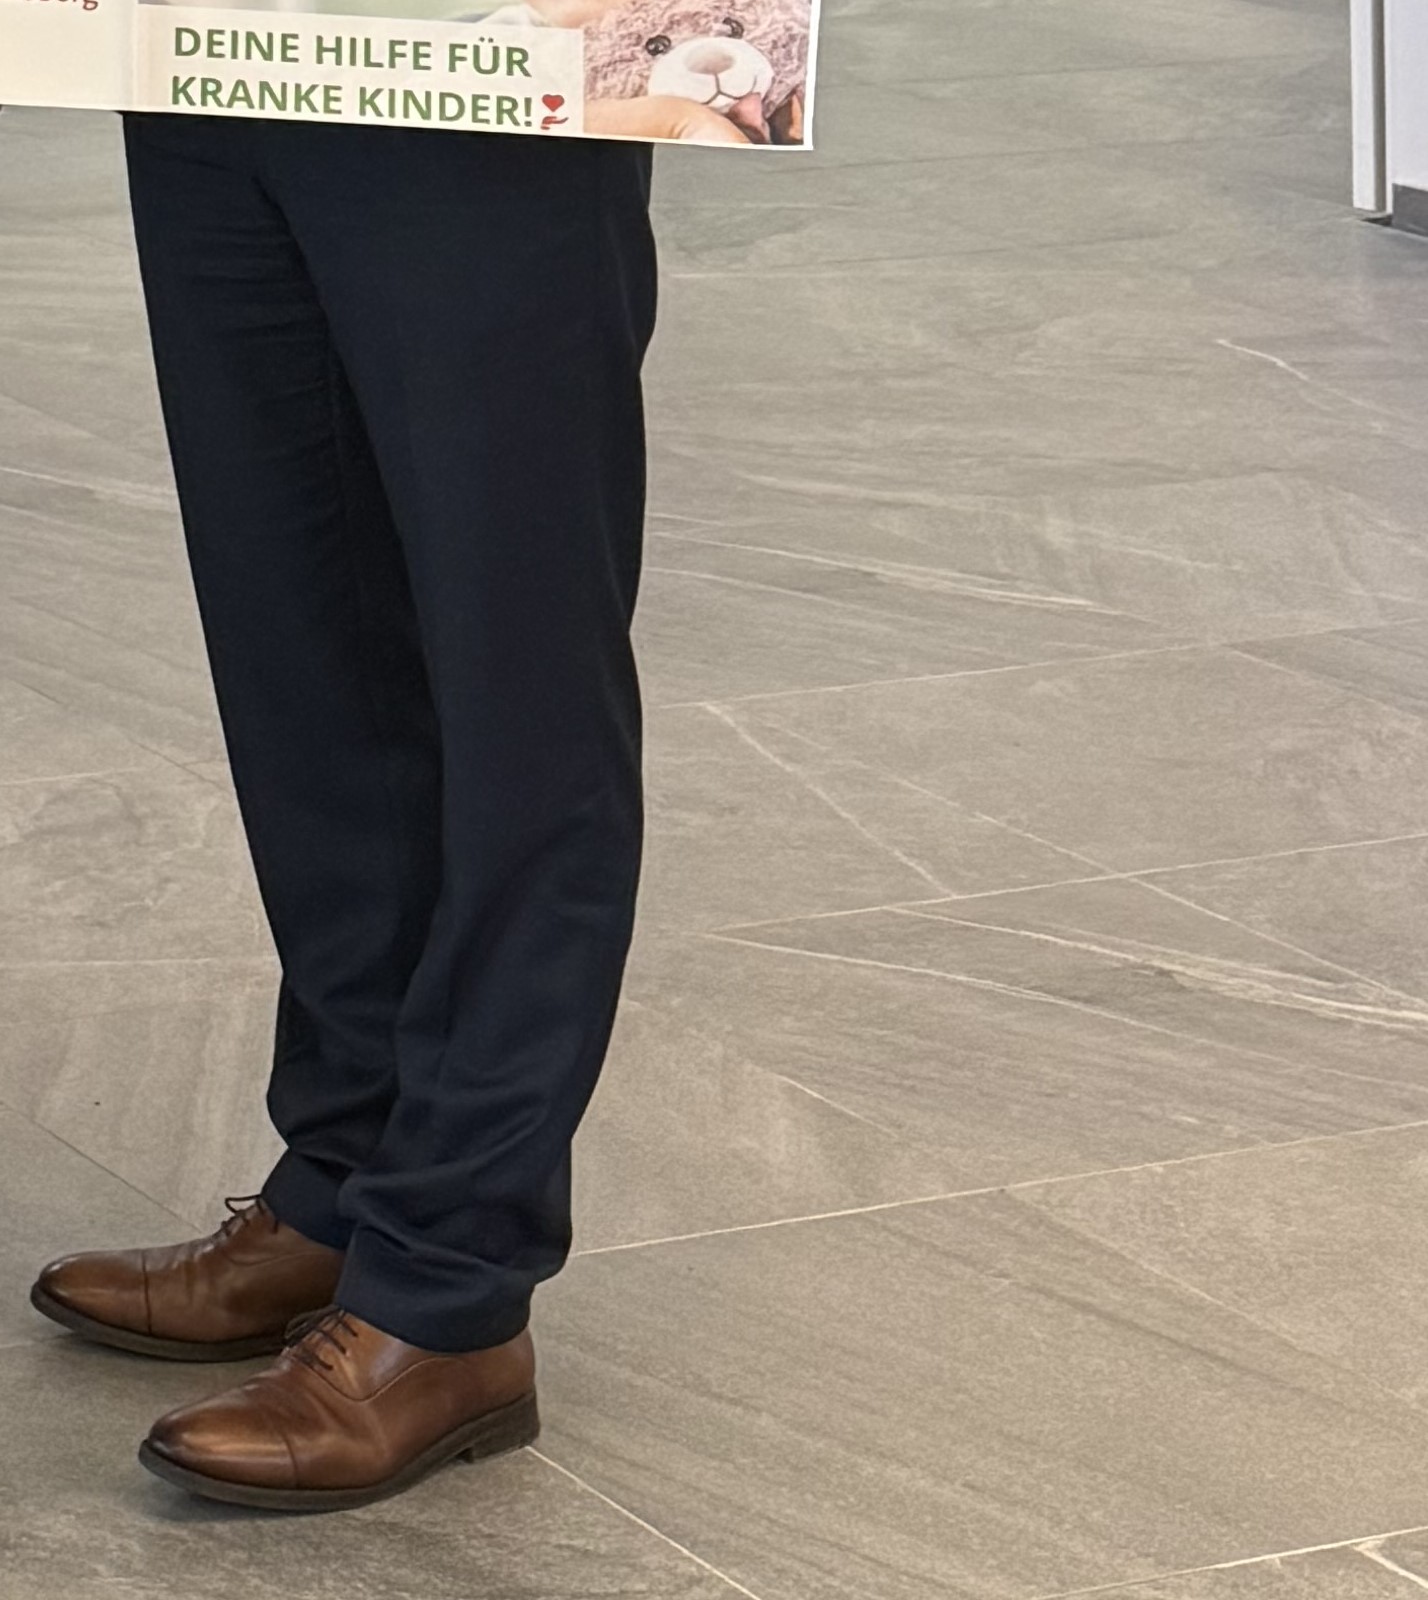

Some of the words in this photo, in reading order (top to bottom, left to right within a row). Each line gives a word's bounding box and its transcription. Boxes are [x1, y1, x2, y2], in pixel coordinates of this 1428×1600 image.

[174, 27, 300, 64] DEINE
[315, 35, 433, 71] HILFE
[447, 37, 533, 78] FÜR
[171, 75, 343, 115] KRANKE
[358, 85, 533, 128] KINDER!
